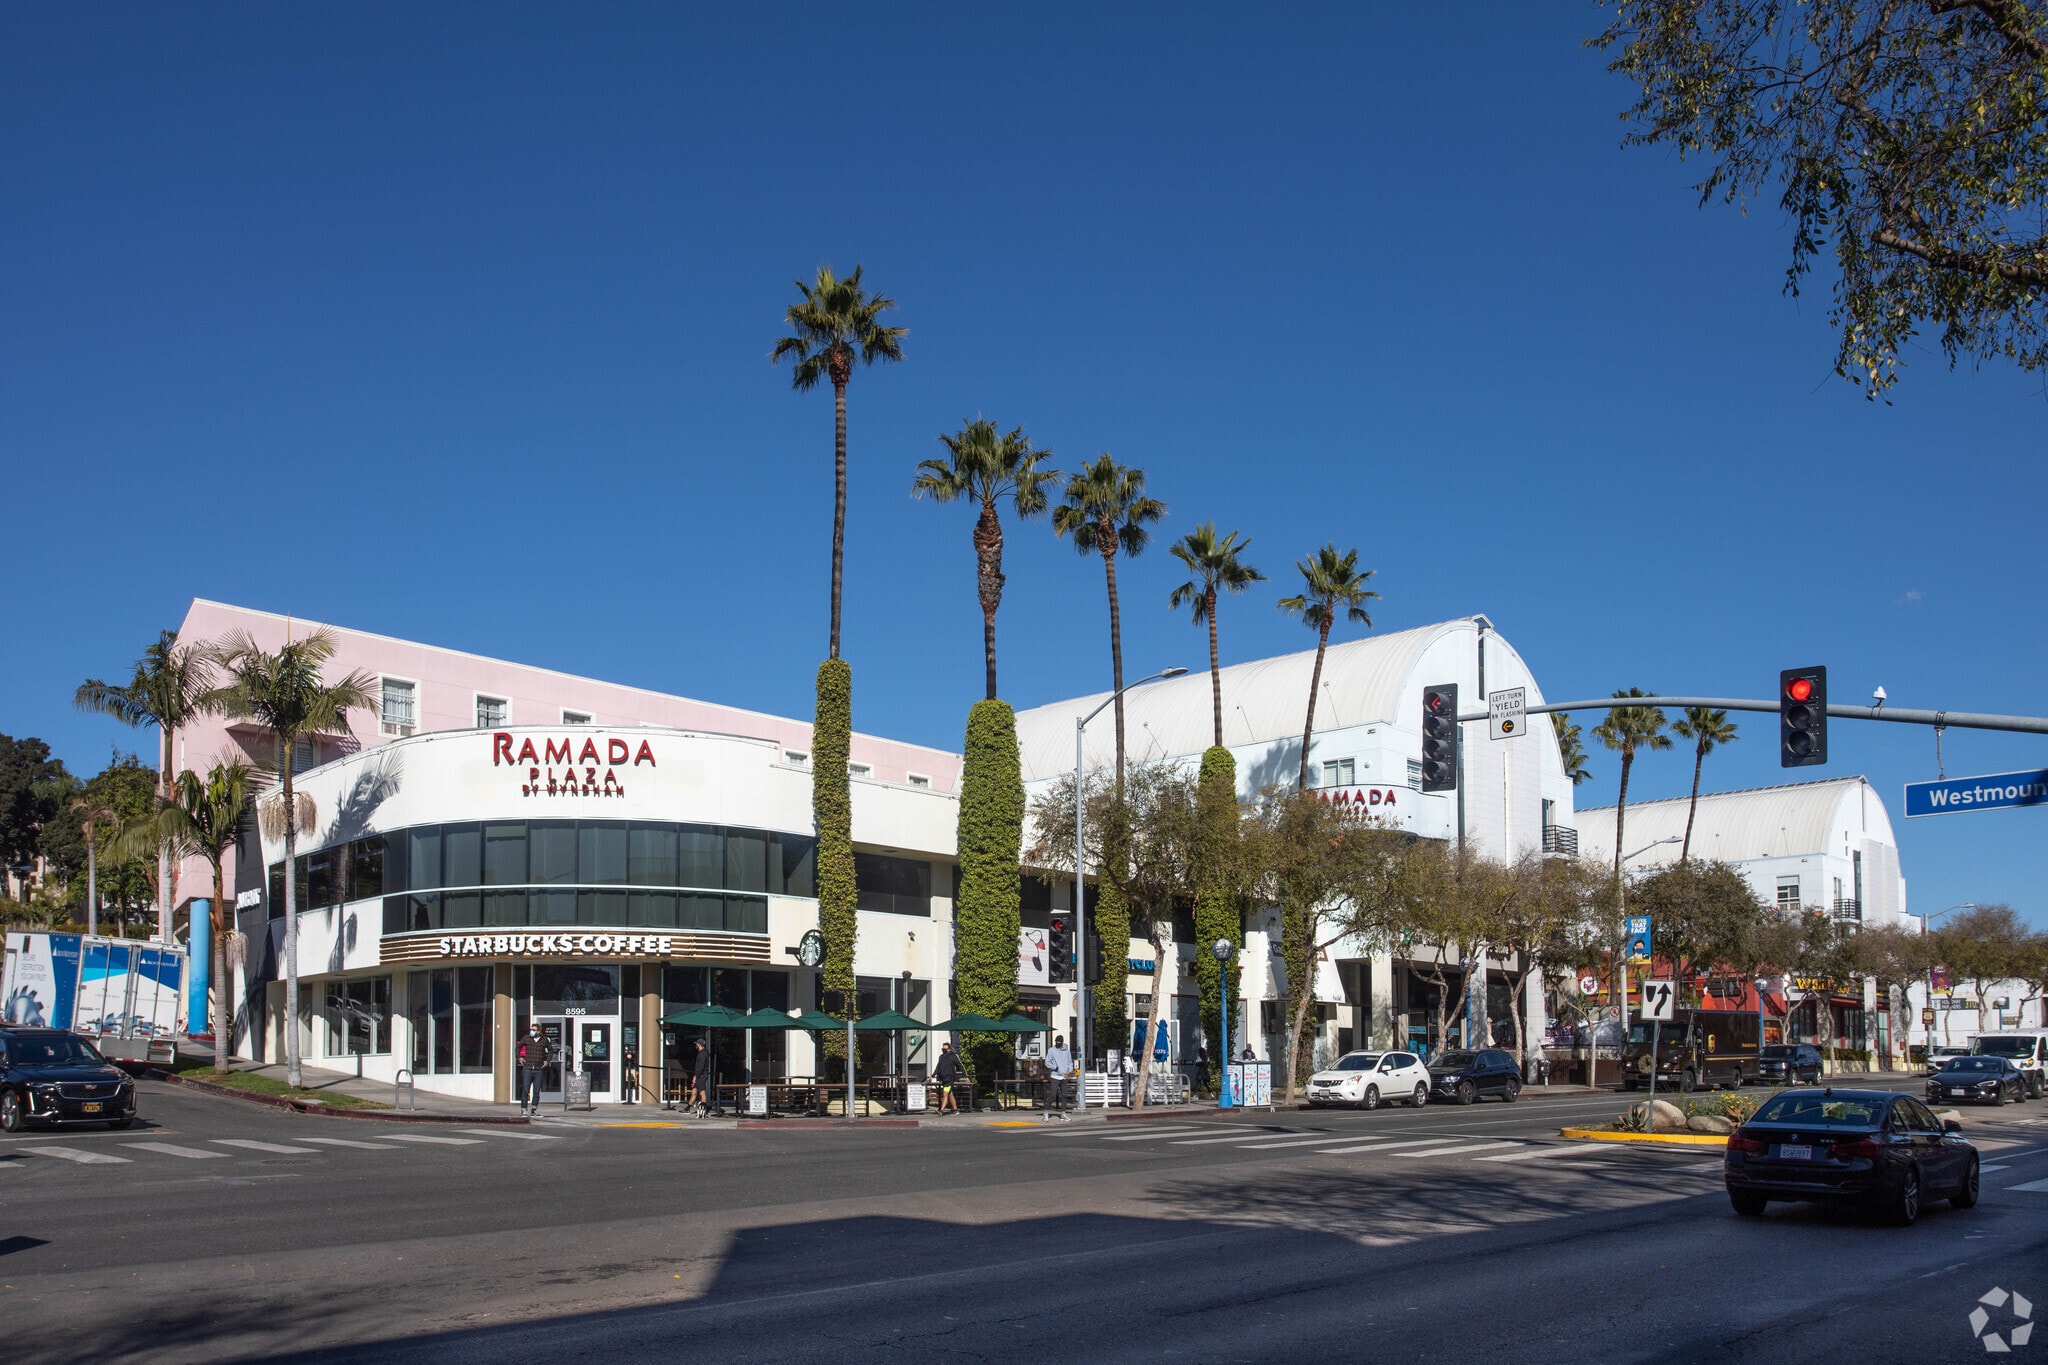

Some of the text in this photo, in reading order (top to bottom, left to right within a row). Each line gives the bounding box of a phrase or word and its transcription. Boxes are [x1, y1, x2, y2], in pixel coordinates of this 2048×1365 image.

[1492, 694, 1505, 702] LEFT
[1500, 709, 1524, 718] FLASHING
[493, 732, 656, 766] RAMADA
[529, 767, 617, 785] PLAZA
[522, 784, 624, 798] BY WYNDHAM
[1929, 783, 2048, 807] Westmoun
[439, 935, 672, 955] STARBUCKS COFFEE
